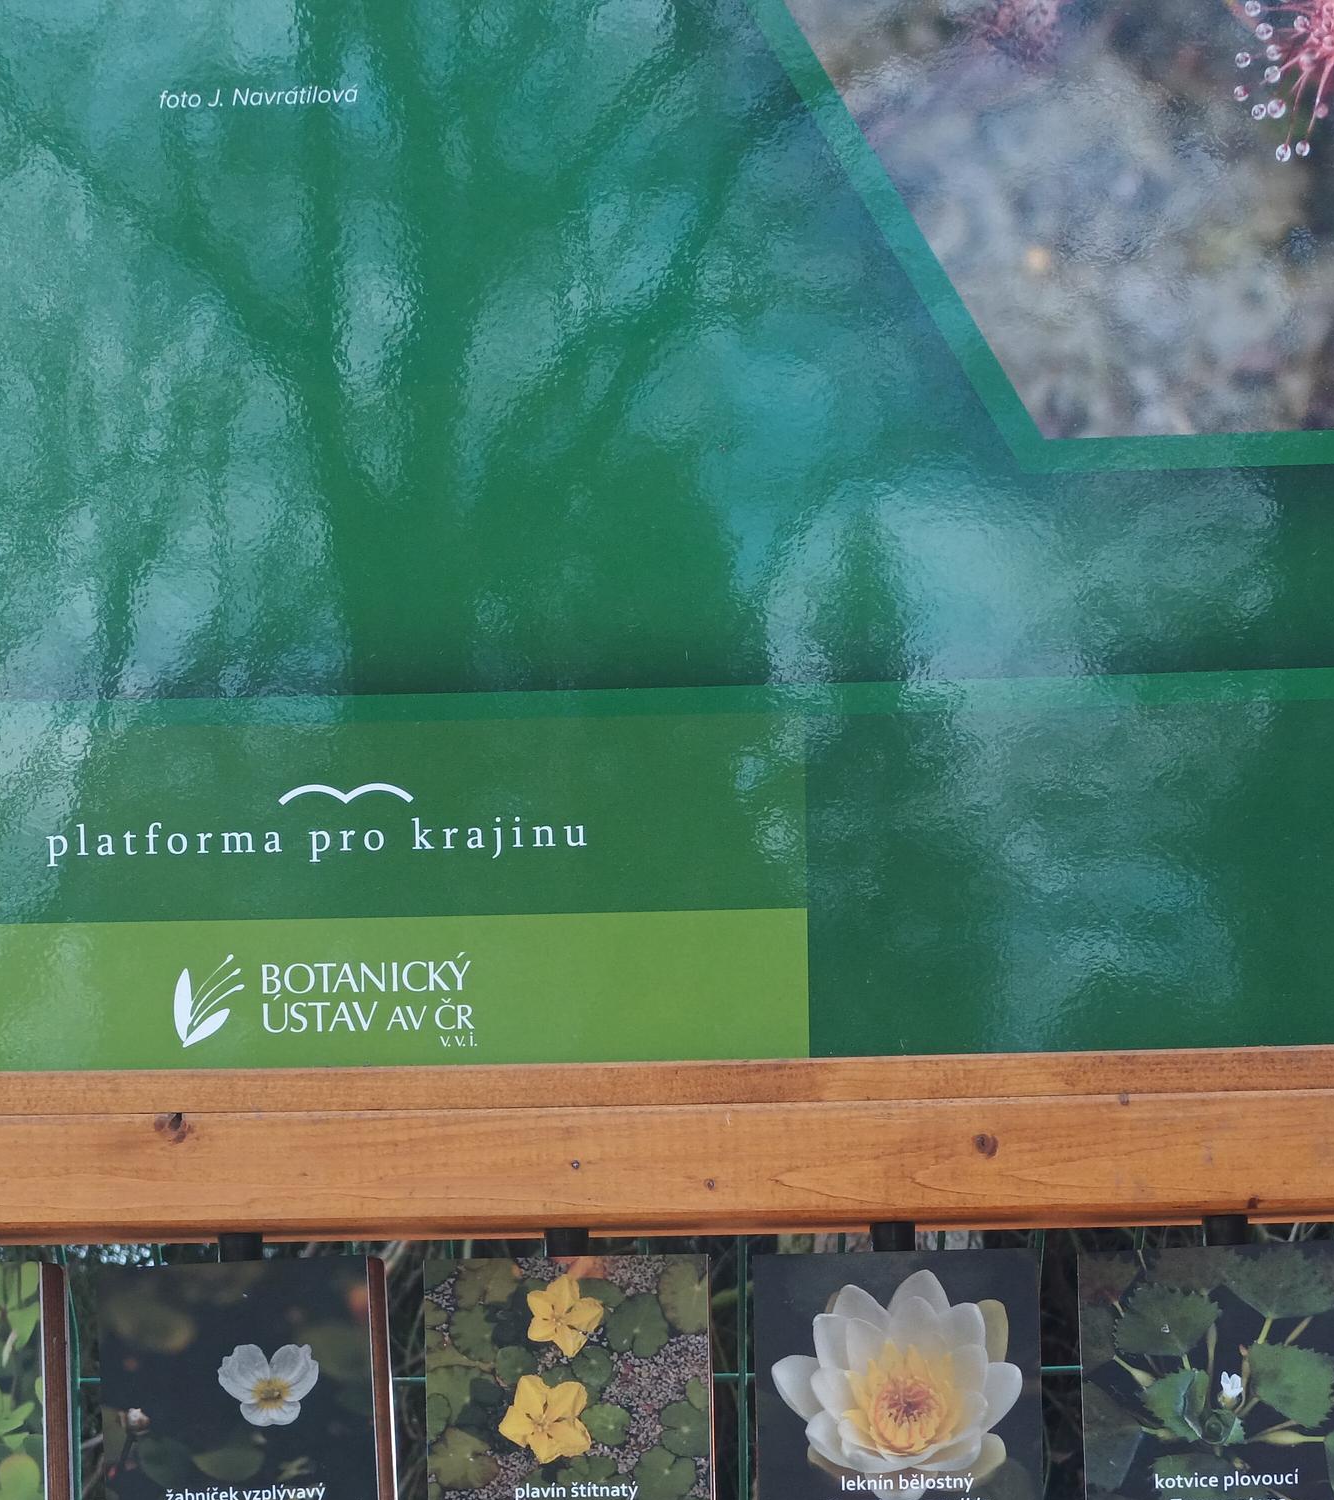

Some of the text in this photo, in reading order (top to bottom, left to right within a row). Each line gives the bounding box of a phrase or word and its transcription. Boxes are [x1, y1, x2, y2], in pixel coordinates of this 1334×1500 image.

[159, 84, 358, 109] foto J. Navrátilová
[46, 816, 587, 867] platforma pro krajinu
[262, 952, 471, 994] BOTANICKÝ
[262, 994, 475, 1033] ÚSTAV AV ČR
[571, 1481, 638, 1500] štítnatý
[841, 1473, 973, 1492] leknín bělostný
[1155, 1469, 1299, 1491] kotvice plovoucí
